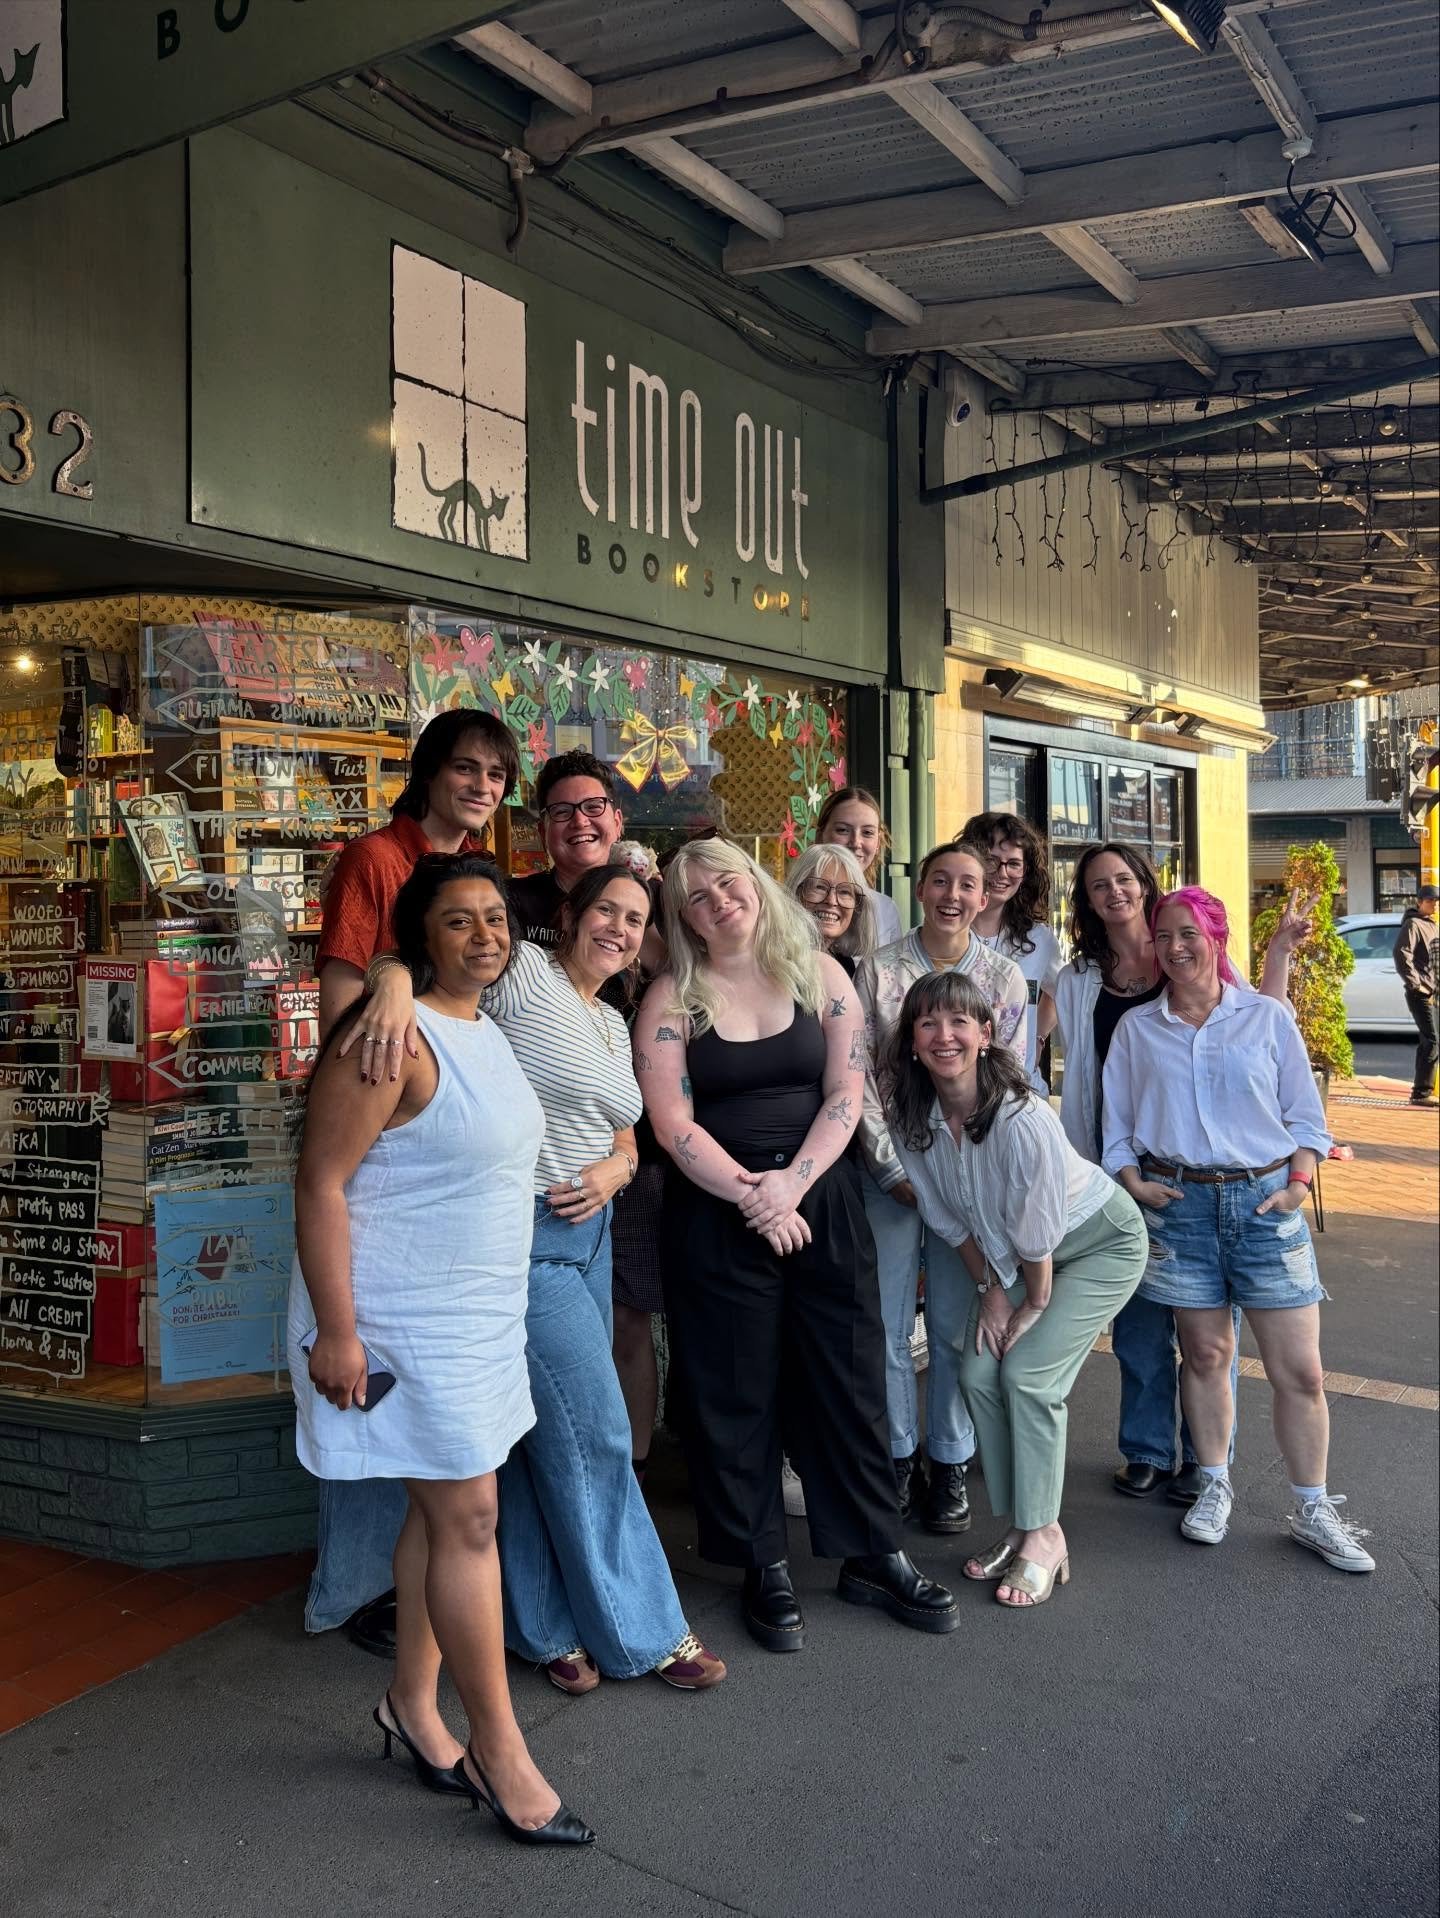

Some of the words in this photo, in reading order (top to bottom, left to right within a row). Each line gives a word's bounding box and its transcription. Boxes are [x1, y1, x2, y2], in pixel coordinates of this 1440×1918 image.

[571, 339, 701, 549] time
[577, 533, 810, 622] BOOKSTORE
[194, 816, 264, 840] THREE
[279, 819, 336, 843] KINGS
[89, 965, 136, 979] MISSING
[199, 999, 245, 1022] ERNIE
[181, 1053, 282, 1079] COMMERCE
[151, 1145, 165, 1156] Cat
[165, 1143, 180, 1154] Zen
[27, 1163, 91, 1188] Strangers
[13, 1230, 46, 1256] Same
[9, 1262, 46, 1288] Poetic
[38, 1305, 84, 1328] CREDIT
[38, 1329, 52, 1361] &
[57, 1339, 80, 1374] dry
